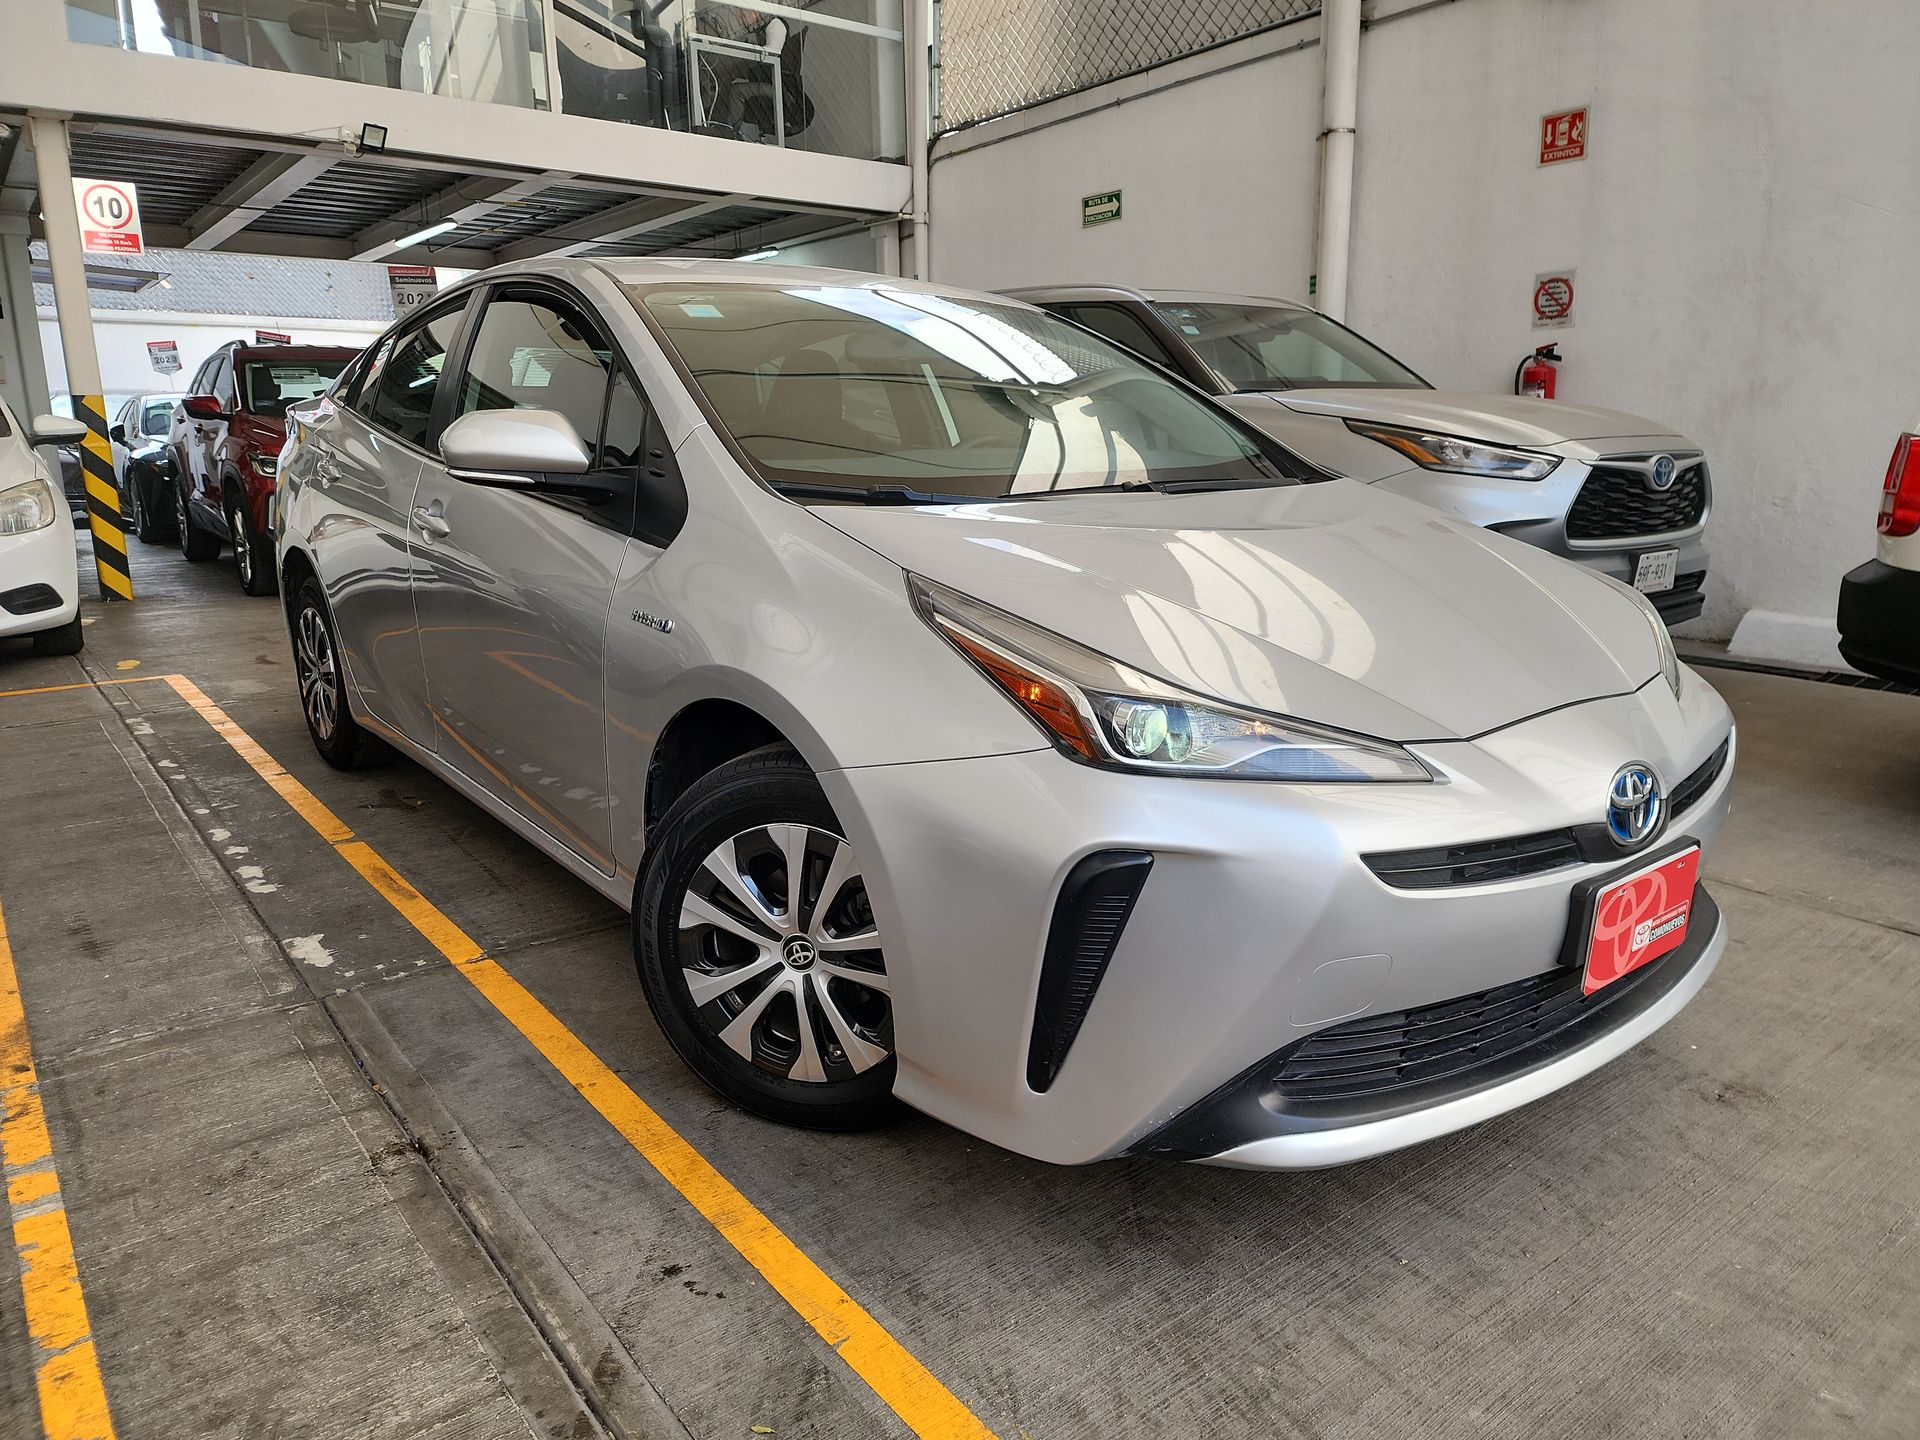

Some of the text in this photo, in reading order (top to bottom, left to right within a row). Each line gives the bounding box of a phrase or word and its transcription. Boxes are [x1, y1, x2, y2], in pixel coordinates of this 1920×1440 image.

[1543, 147, 1581, 161] EXTINTOR
[1088, 196, 1109, 206] RUTA DE
[93, 196, 123, 219] 10
[394, 276, 433, 284] Seminuevos
